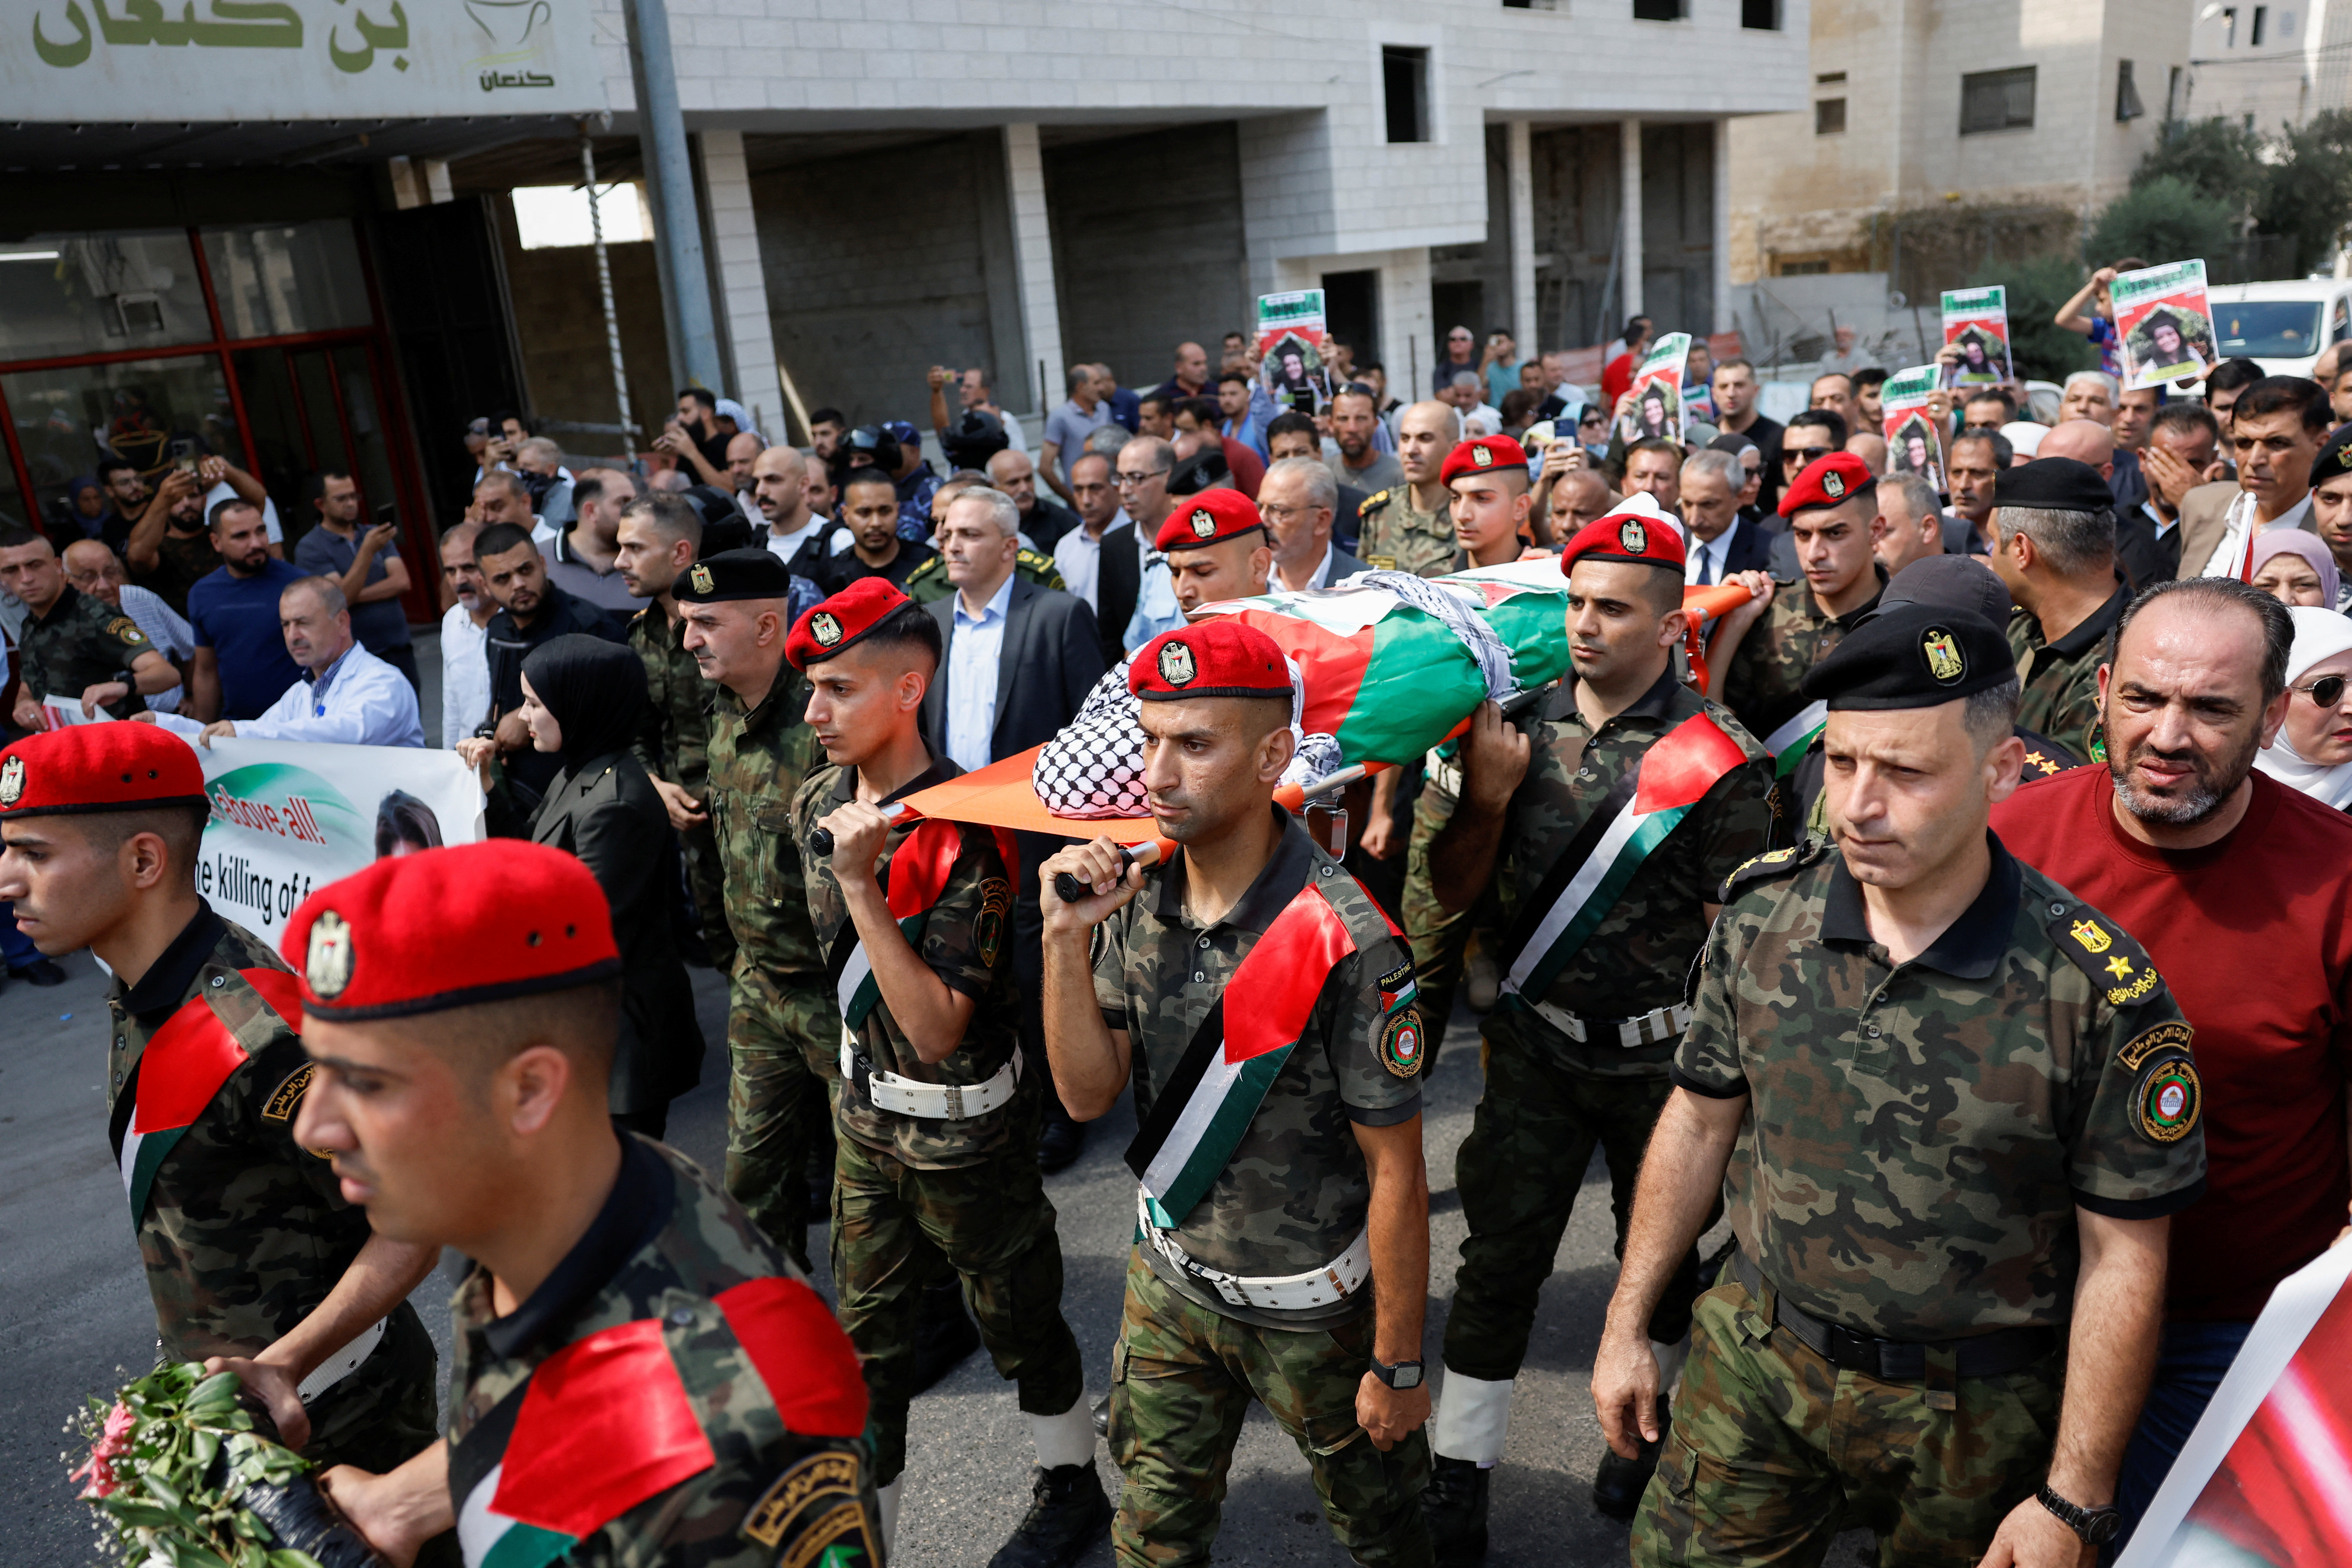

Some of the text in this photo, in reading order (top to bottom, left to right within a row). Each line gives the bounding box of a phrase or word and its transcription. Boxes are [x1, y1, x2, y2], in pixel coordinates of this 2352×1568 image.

[480, 70, 555, 92] كنعان
[216, 785, 286, 837] above
[282, 796, 326, 844] all!
[218, 853, 272, 925] killing
[279, 873, 298, 919] of
[1381, 962, 1411, 987] PALESTINE
